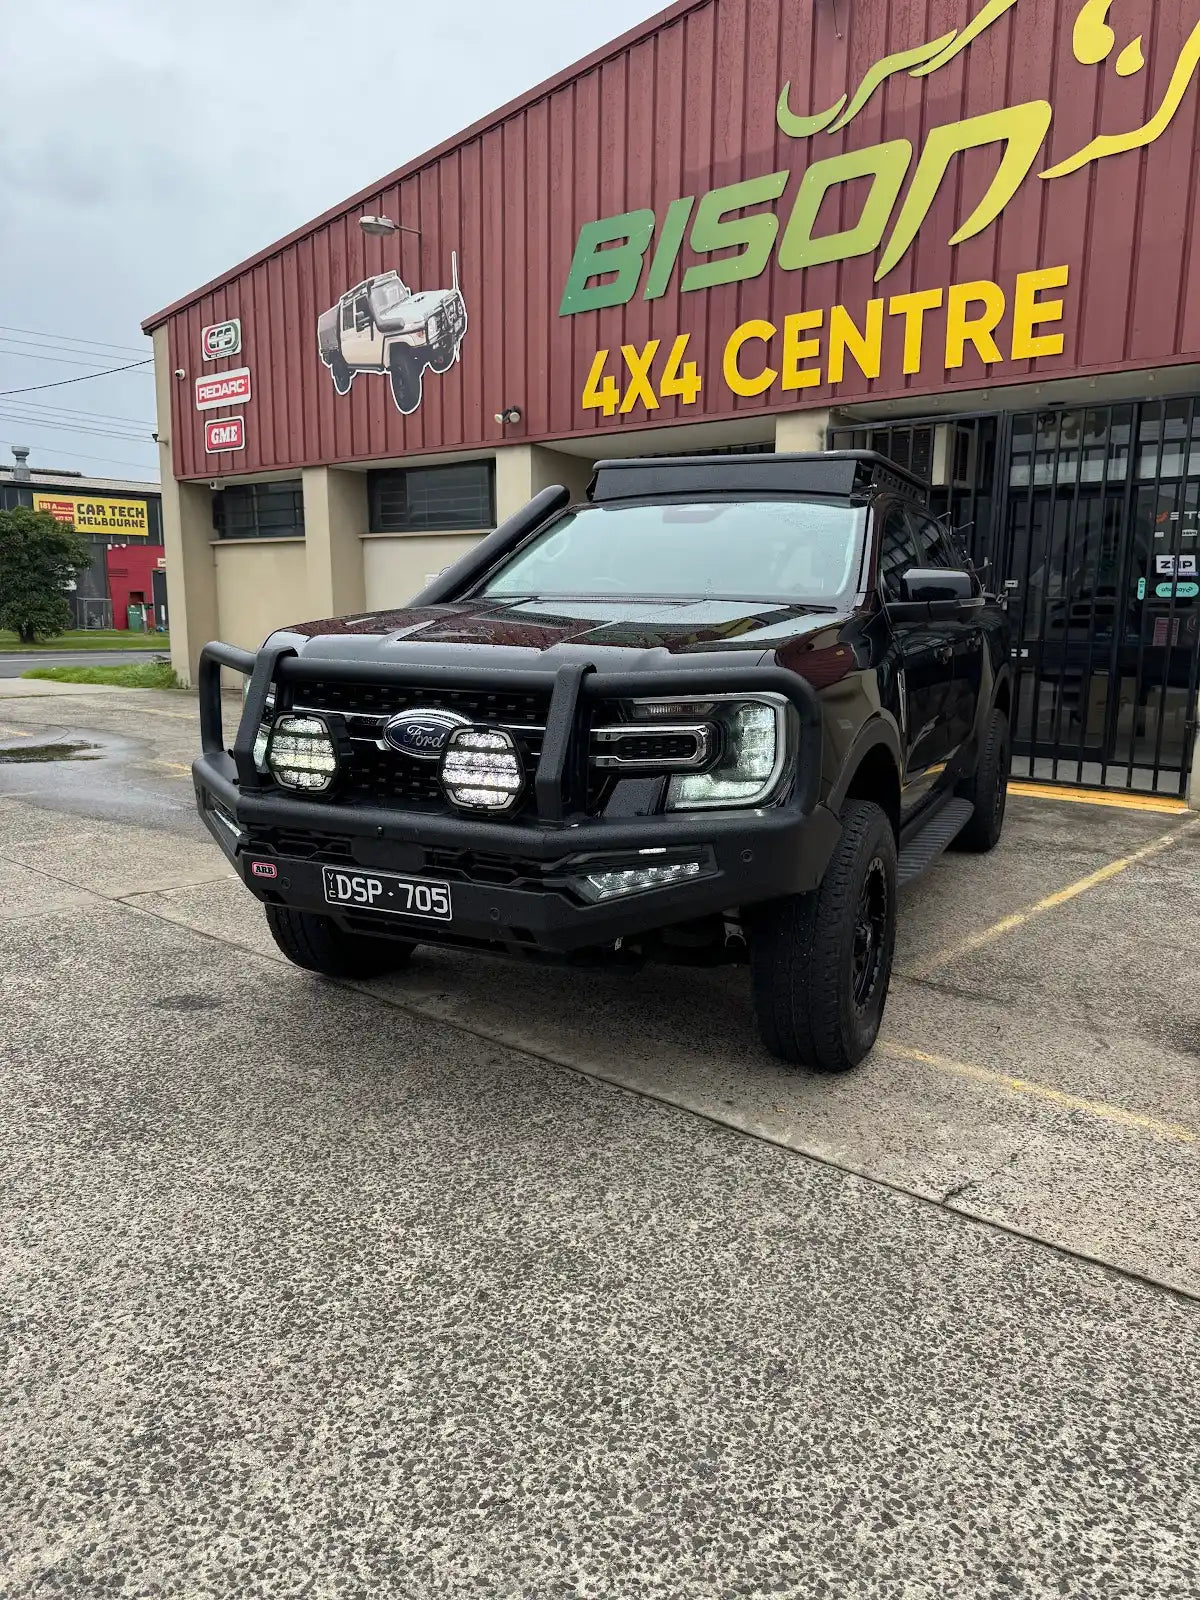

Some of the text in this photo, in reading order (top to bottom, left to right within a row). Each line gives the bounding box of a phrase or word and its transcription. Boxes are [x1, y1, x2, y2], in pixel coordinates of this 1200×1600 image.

[582, 265, 1069, 417] 4X4 CENTRE
[199, 379, 246, 400] REDARC
[210, 425, 238, 445] GME
[77, 503, 106, 516] CAR
[109, 505, 145, 518] TECH
[78, 516, 146, 528] MELBOURNE
[403, 724, 446, 748] Ford
[255, 865, 274, 875] ARB
[327, 872, 337, 898] VIC
[336, 875, 449, 914] DSP 705
